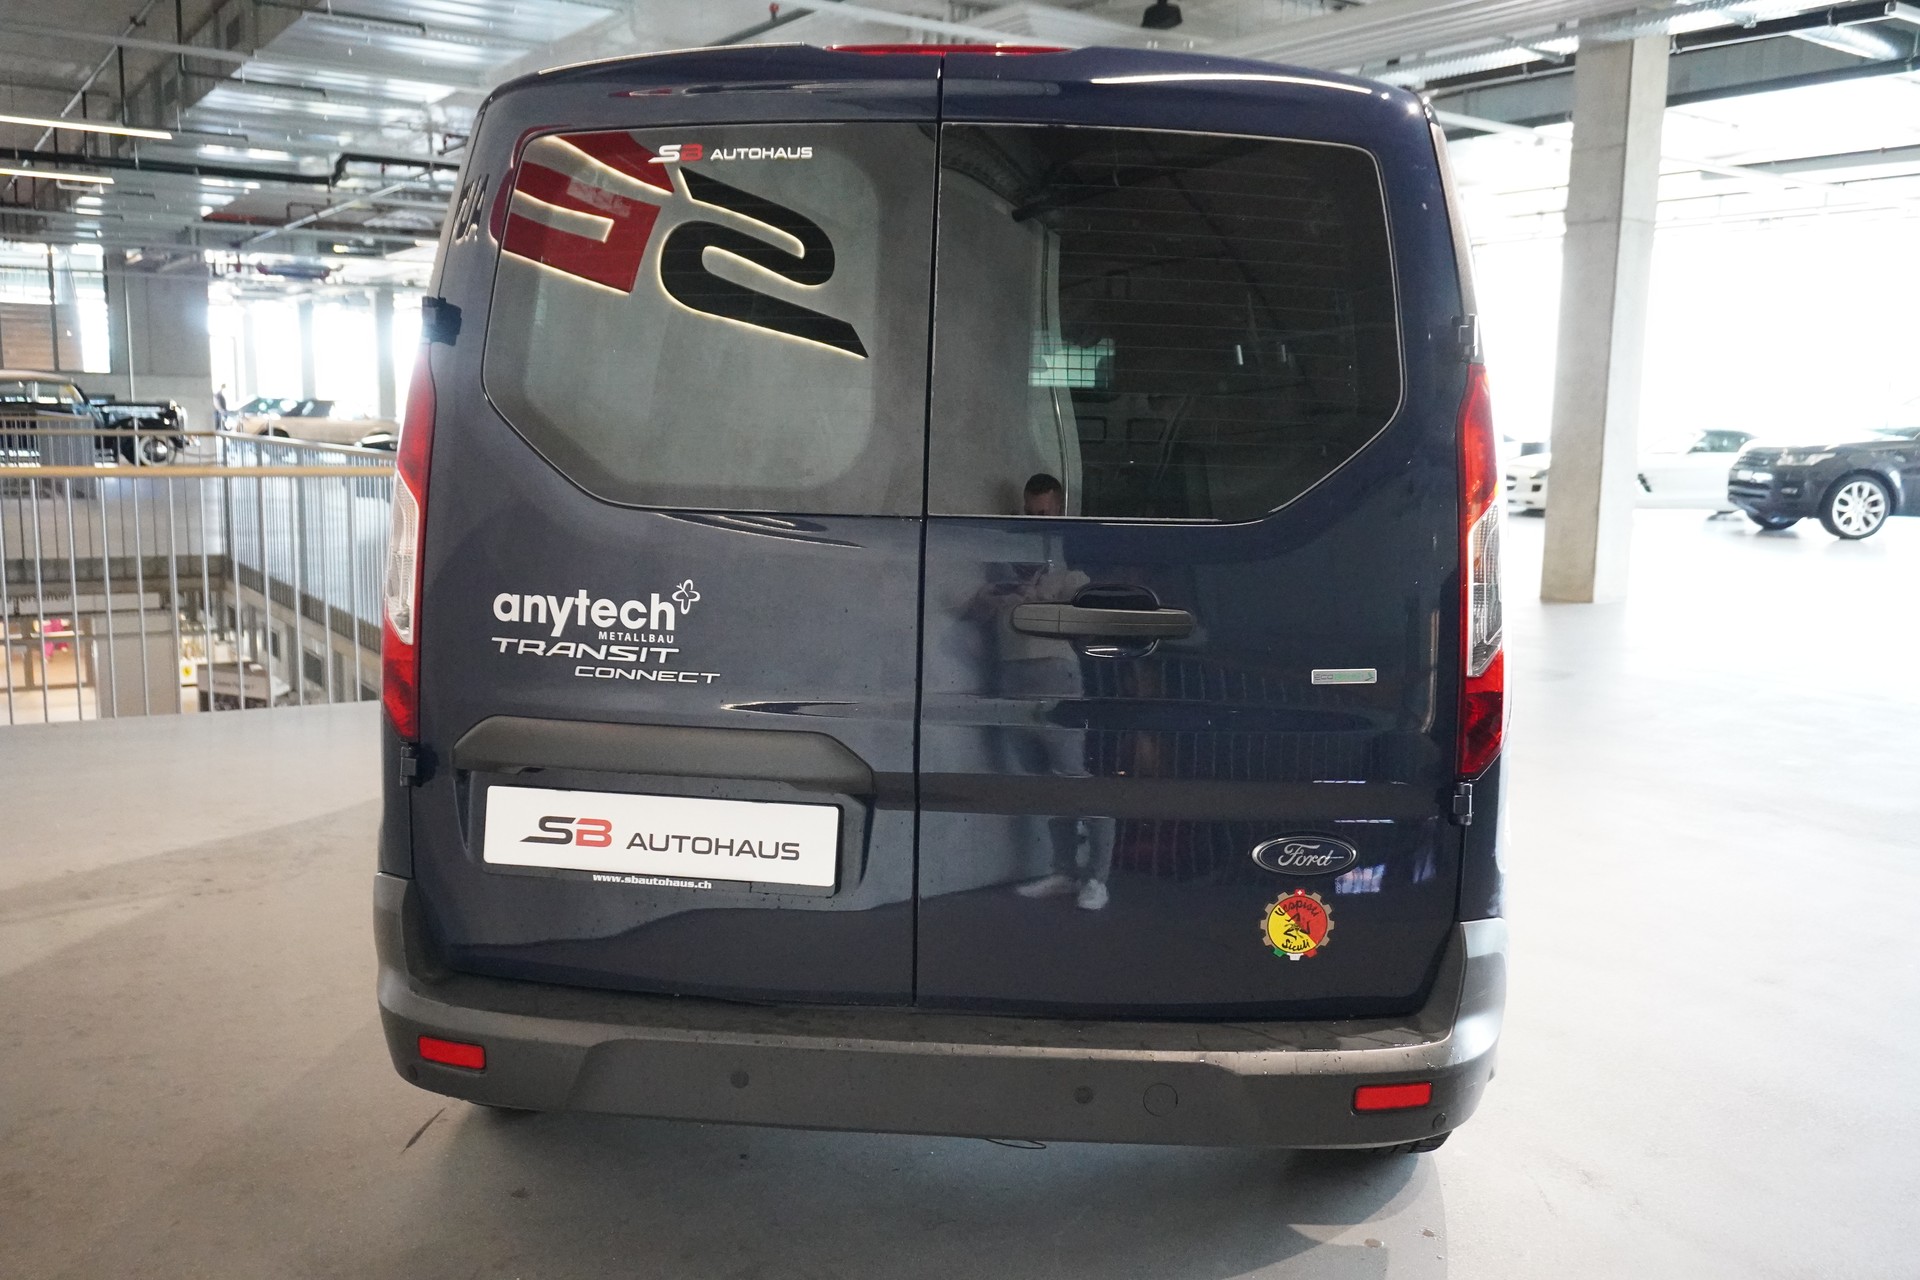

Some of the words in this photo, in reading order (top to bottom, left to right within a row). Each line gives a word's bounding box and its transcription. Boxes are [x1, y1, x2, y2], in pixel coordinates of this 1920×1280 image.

[648, 143, 703, 163] SB
[710, 146, 813, 161] AUTOHAUS
[493, 589, 676, 637] anytech
[598, 631, 674, 644] METALLBAU
[491, 637, 679, 664] TRANSIT
[574, 665, 721, 684] CONNECT
[520, 815, 612, 848] SB
[626, 832, 800, 861] AUTOHAUS
[1278, 843, 1344, 866] Ford
[592, 873, 712, 889] www.sbautohaus.ch
